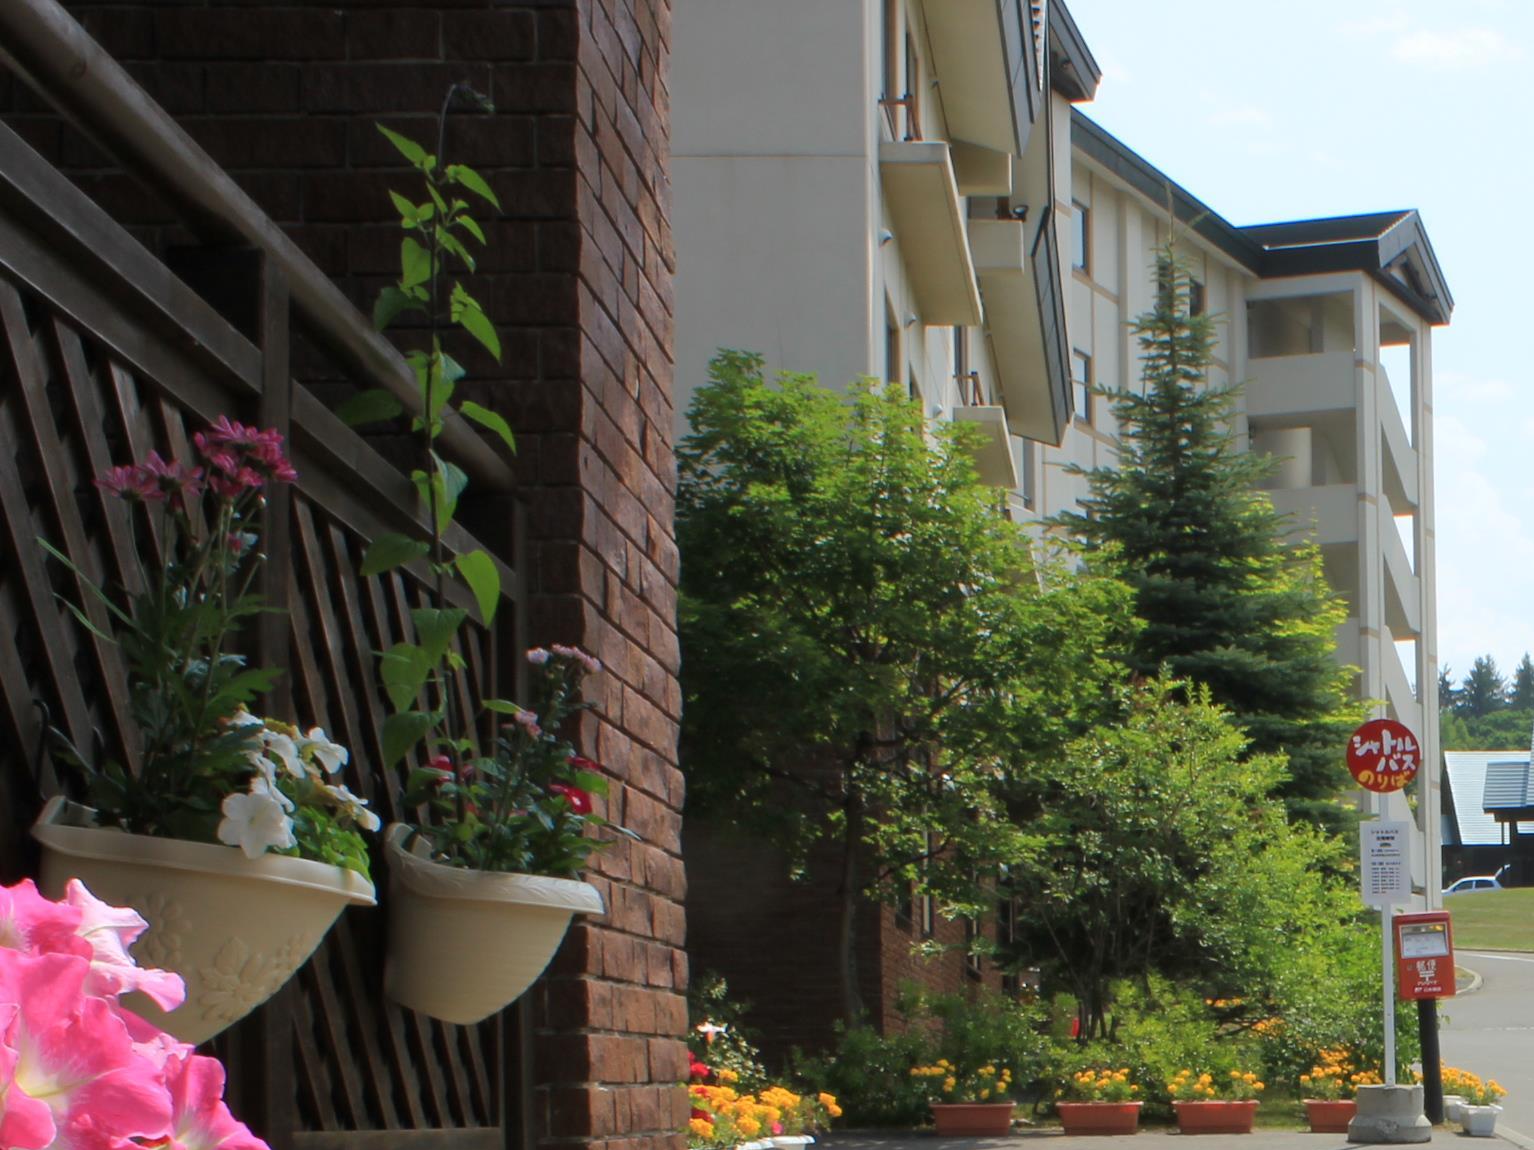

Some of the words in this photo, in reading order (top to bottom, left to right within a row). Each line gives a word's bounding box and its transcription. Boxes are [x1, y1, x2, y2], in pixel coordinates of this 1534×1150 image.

[1353, 729, 1417, 756] シャトル
[1376, 753, 1416, 772] バス
[1358, 770, 1410, 789] のりば
